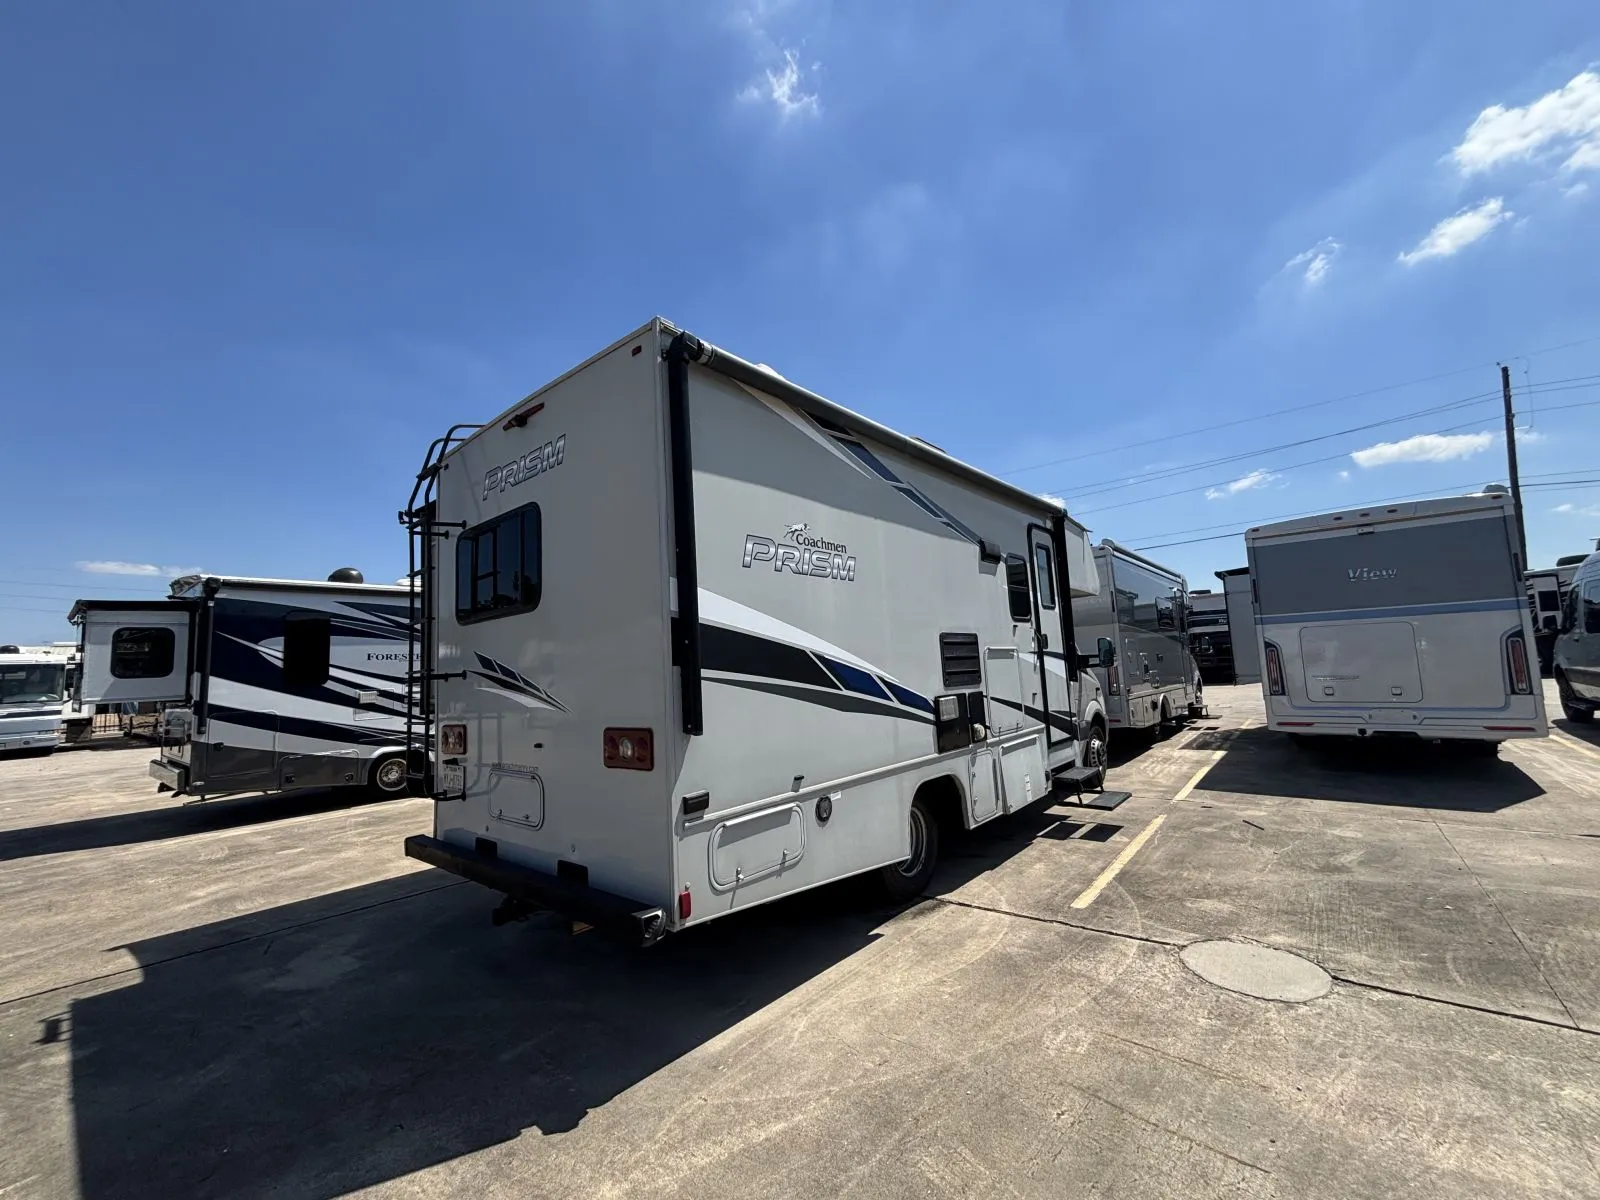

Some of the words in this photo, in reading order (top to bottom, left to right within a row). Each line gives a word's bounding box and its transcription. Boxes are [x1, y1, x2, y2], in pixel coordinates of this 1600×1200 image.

[482, 433, 566, 501] PRISM
[742, 534, 857, 581] PRISM
[796, 533, 847, 554] Coachmen
[1347, 567, 1397, 582] View
